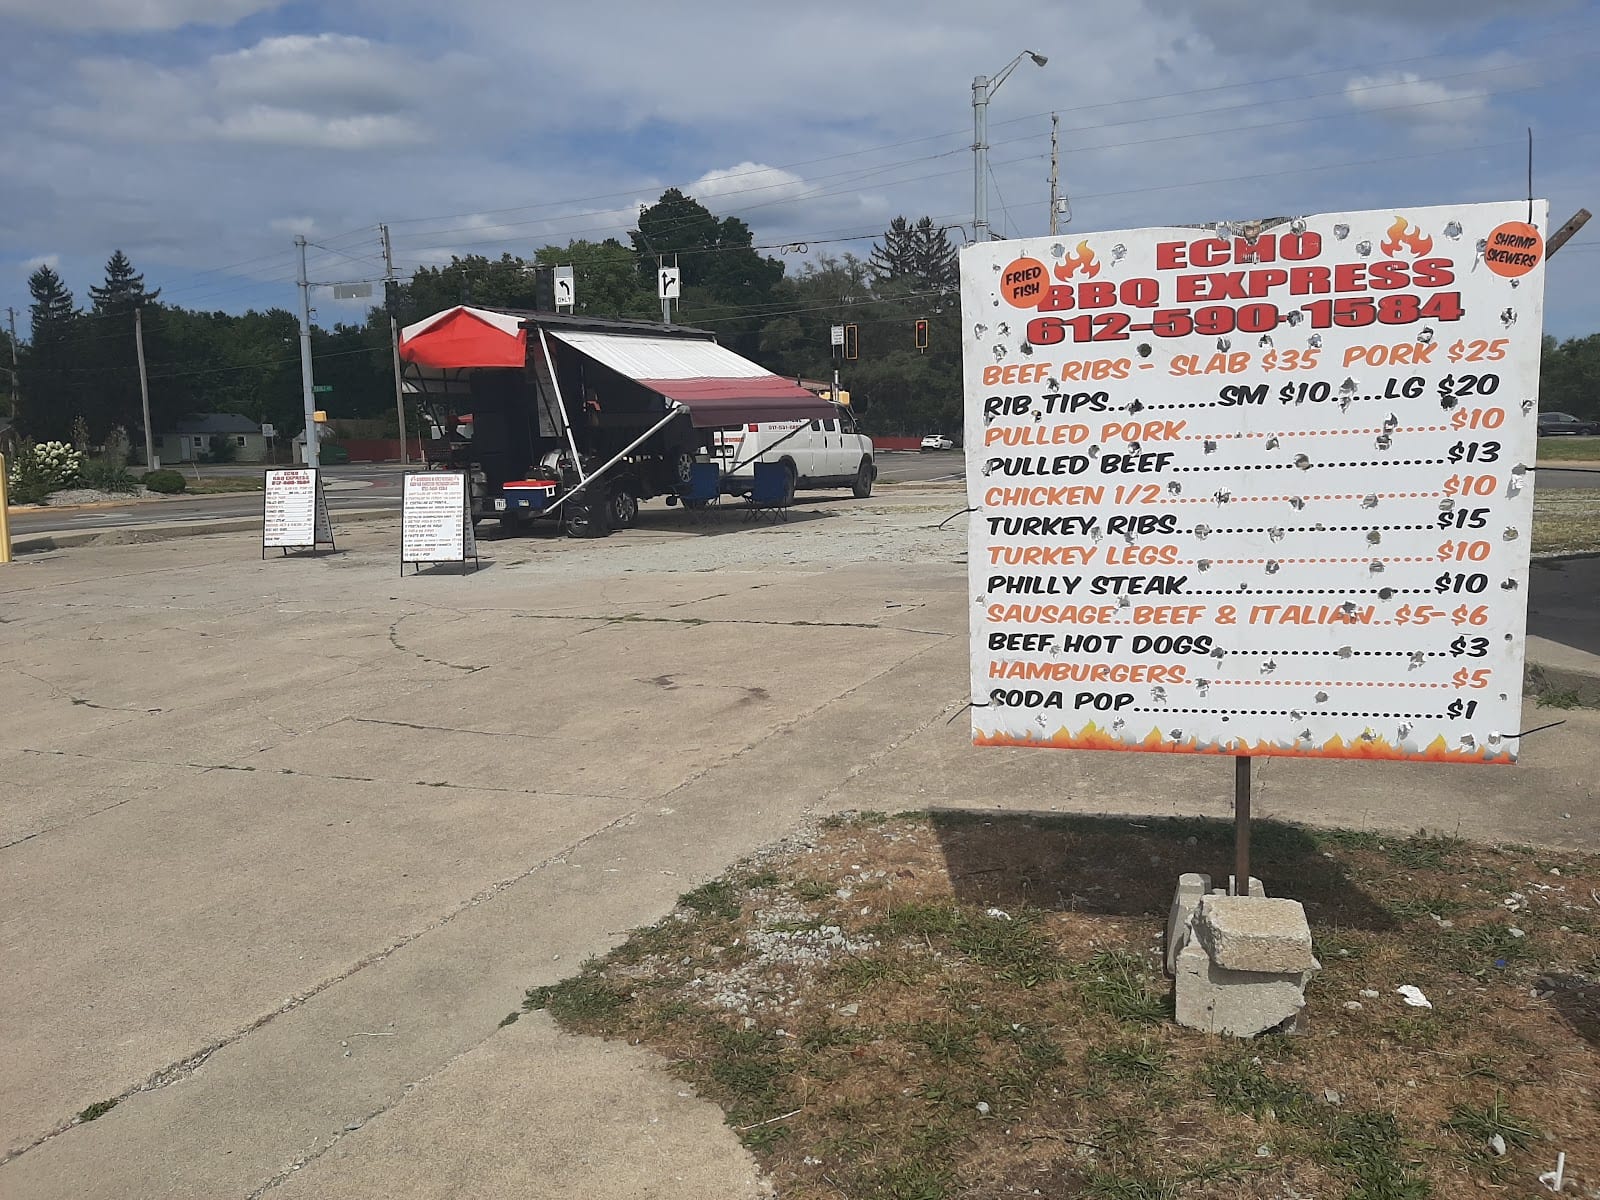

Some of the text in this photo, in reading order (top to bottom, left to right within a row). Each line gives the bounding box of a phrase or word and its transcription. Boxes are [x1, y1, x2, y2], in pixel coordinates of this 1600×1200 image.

[1495, 233, 1536, 249] SHRIMP
[1487, 248, 1536, 267] SKEWERS
[1006, 267, 1041, 285] FRIED
[1013, 282, 1039, 299] FISH
[1037, 258, 1455, 312] BBQ EXPRESS
[1026, 292, 1466, 345] 612-590-1584
[982, 362, 1052, 386] BEEF
[1061, 358, 1131, 381] RIBS
[1168, 351, 1251, 376] SLAB
[1261, 348, 1321, 373] $35
[1342, 342, 1438, 368] PORK
[1447, 338, 1510, 364] $25
[984, 372, 1500, 417] RIB TIPS SM $10 LG $20
[984, 407, 1505, 447] PULLED PORK $10
[984, 440, 1501, 477] PULLED BEEF $13
[984, 474, 1497, 507] CHICKEN 1/2 $10
[987, 507, 1491, 536] TURKEY RIBS $15
[987, 540, 1491, 566] TURKEY LEGS $10
[987, 572, 1489, 596] PHILLY STEAK $10
[986, 604, 1115, 625] SAUSAGE
[1132, 605, 1207, 624] BEEF
[1214, 605, 1237, 624] &
[1249, 605, 1375, 625] ITALIAN
[988, 632, 1490, 659] BEEF HOT DOGS $3
[988, 661, 1491, 690] HAMBURGERS $5
[990, 689, 1477, 720] SODA POP $1
